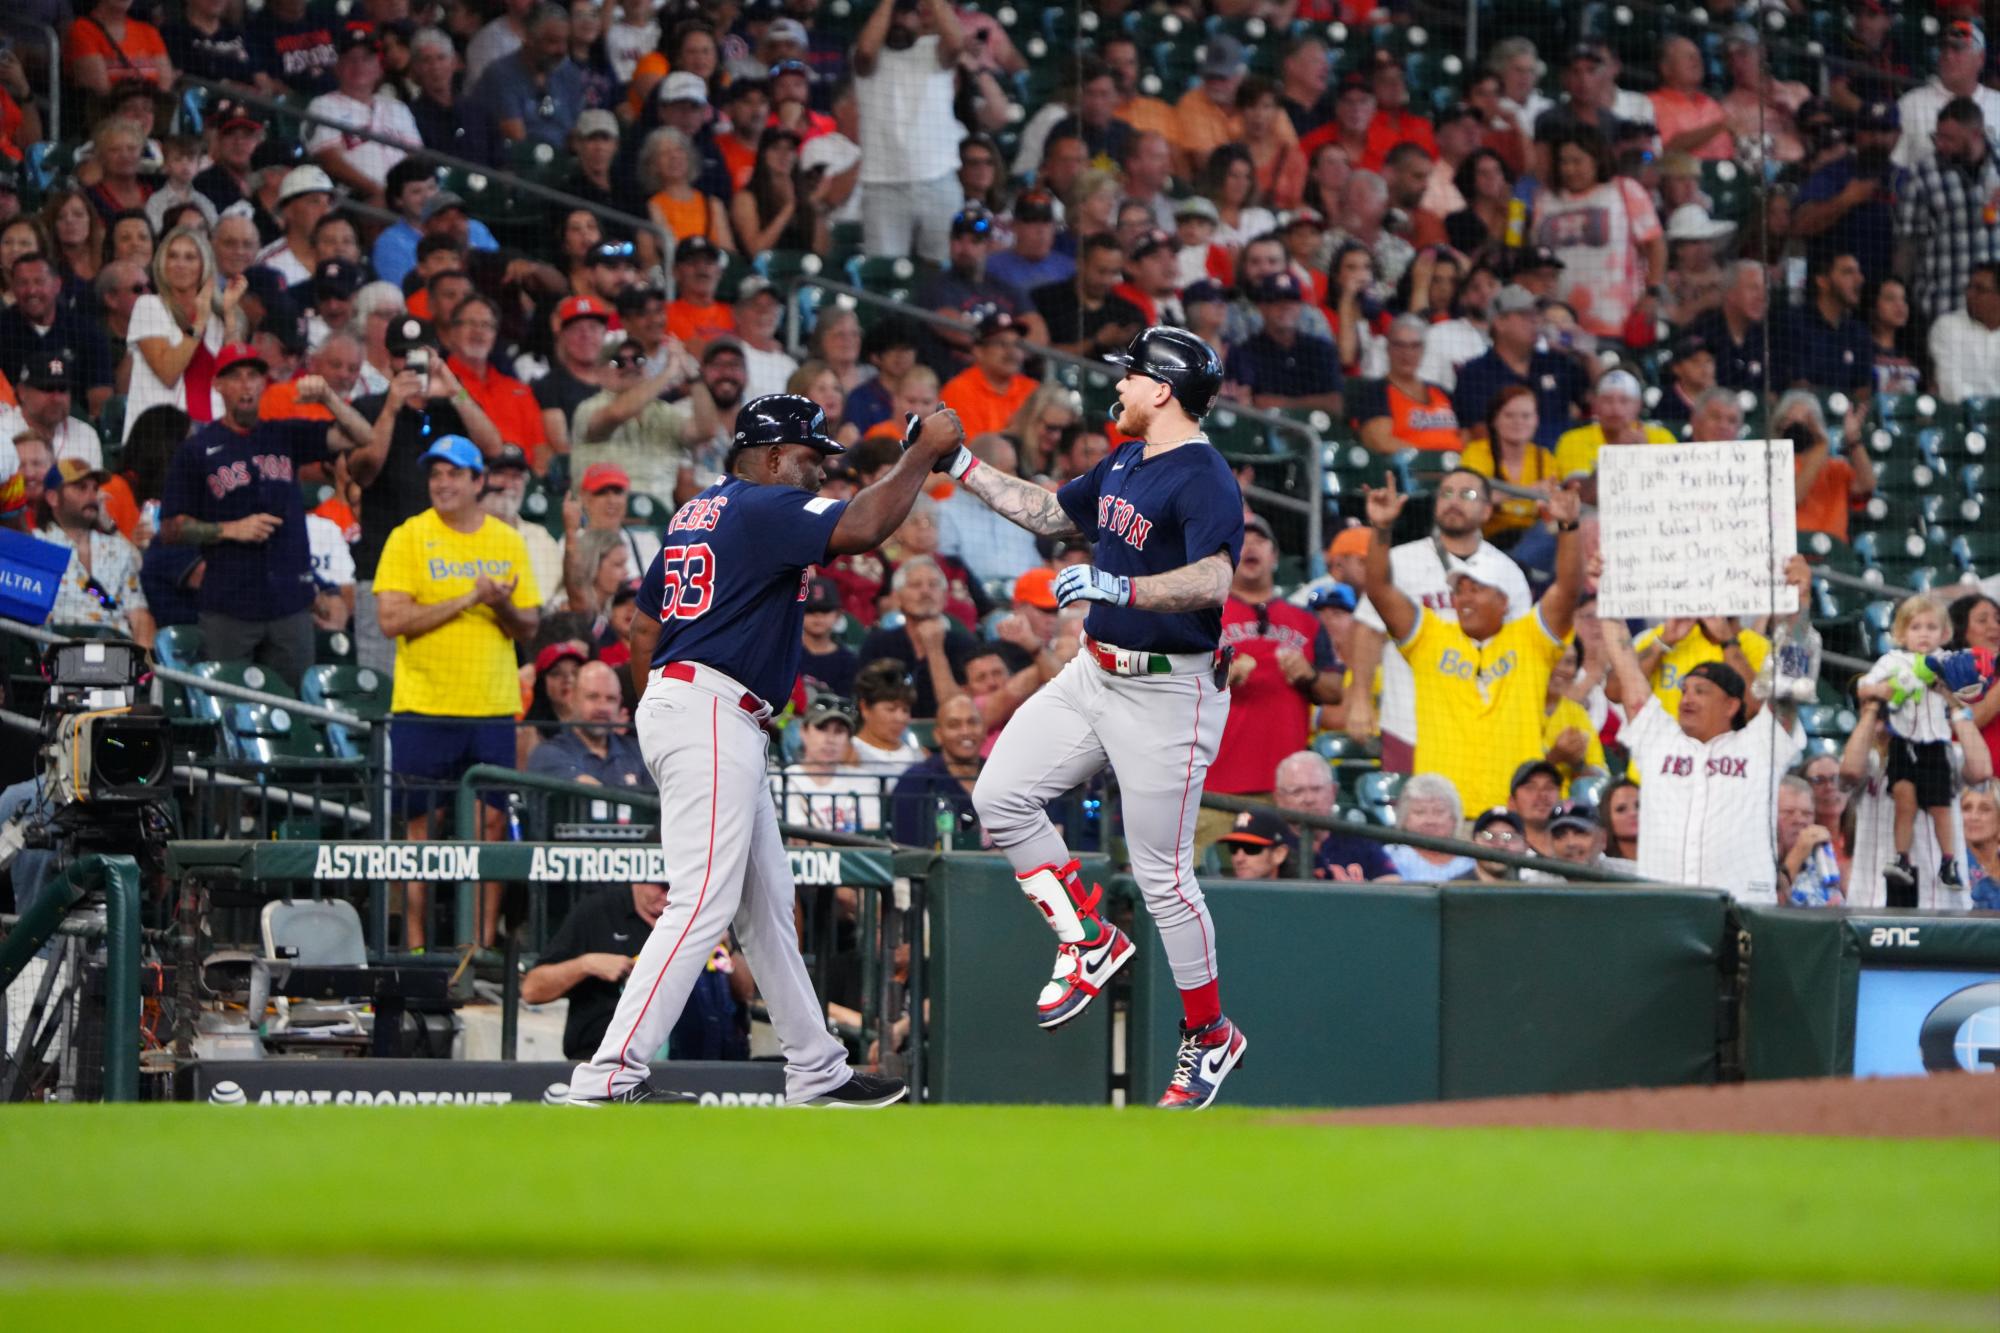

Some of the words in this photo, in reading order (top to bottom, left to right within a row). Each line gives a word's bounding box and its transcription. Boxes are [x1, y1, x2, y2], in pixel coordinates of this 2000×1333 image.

[1098, 494, 1153, 551] STON
[660, 542, 715, 622] 53
[314, 844, 480, 880] ASTROS.COM
[1870, 927, 1920, 947] anc
